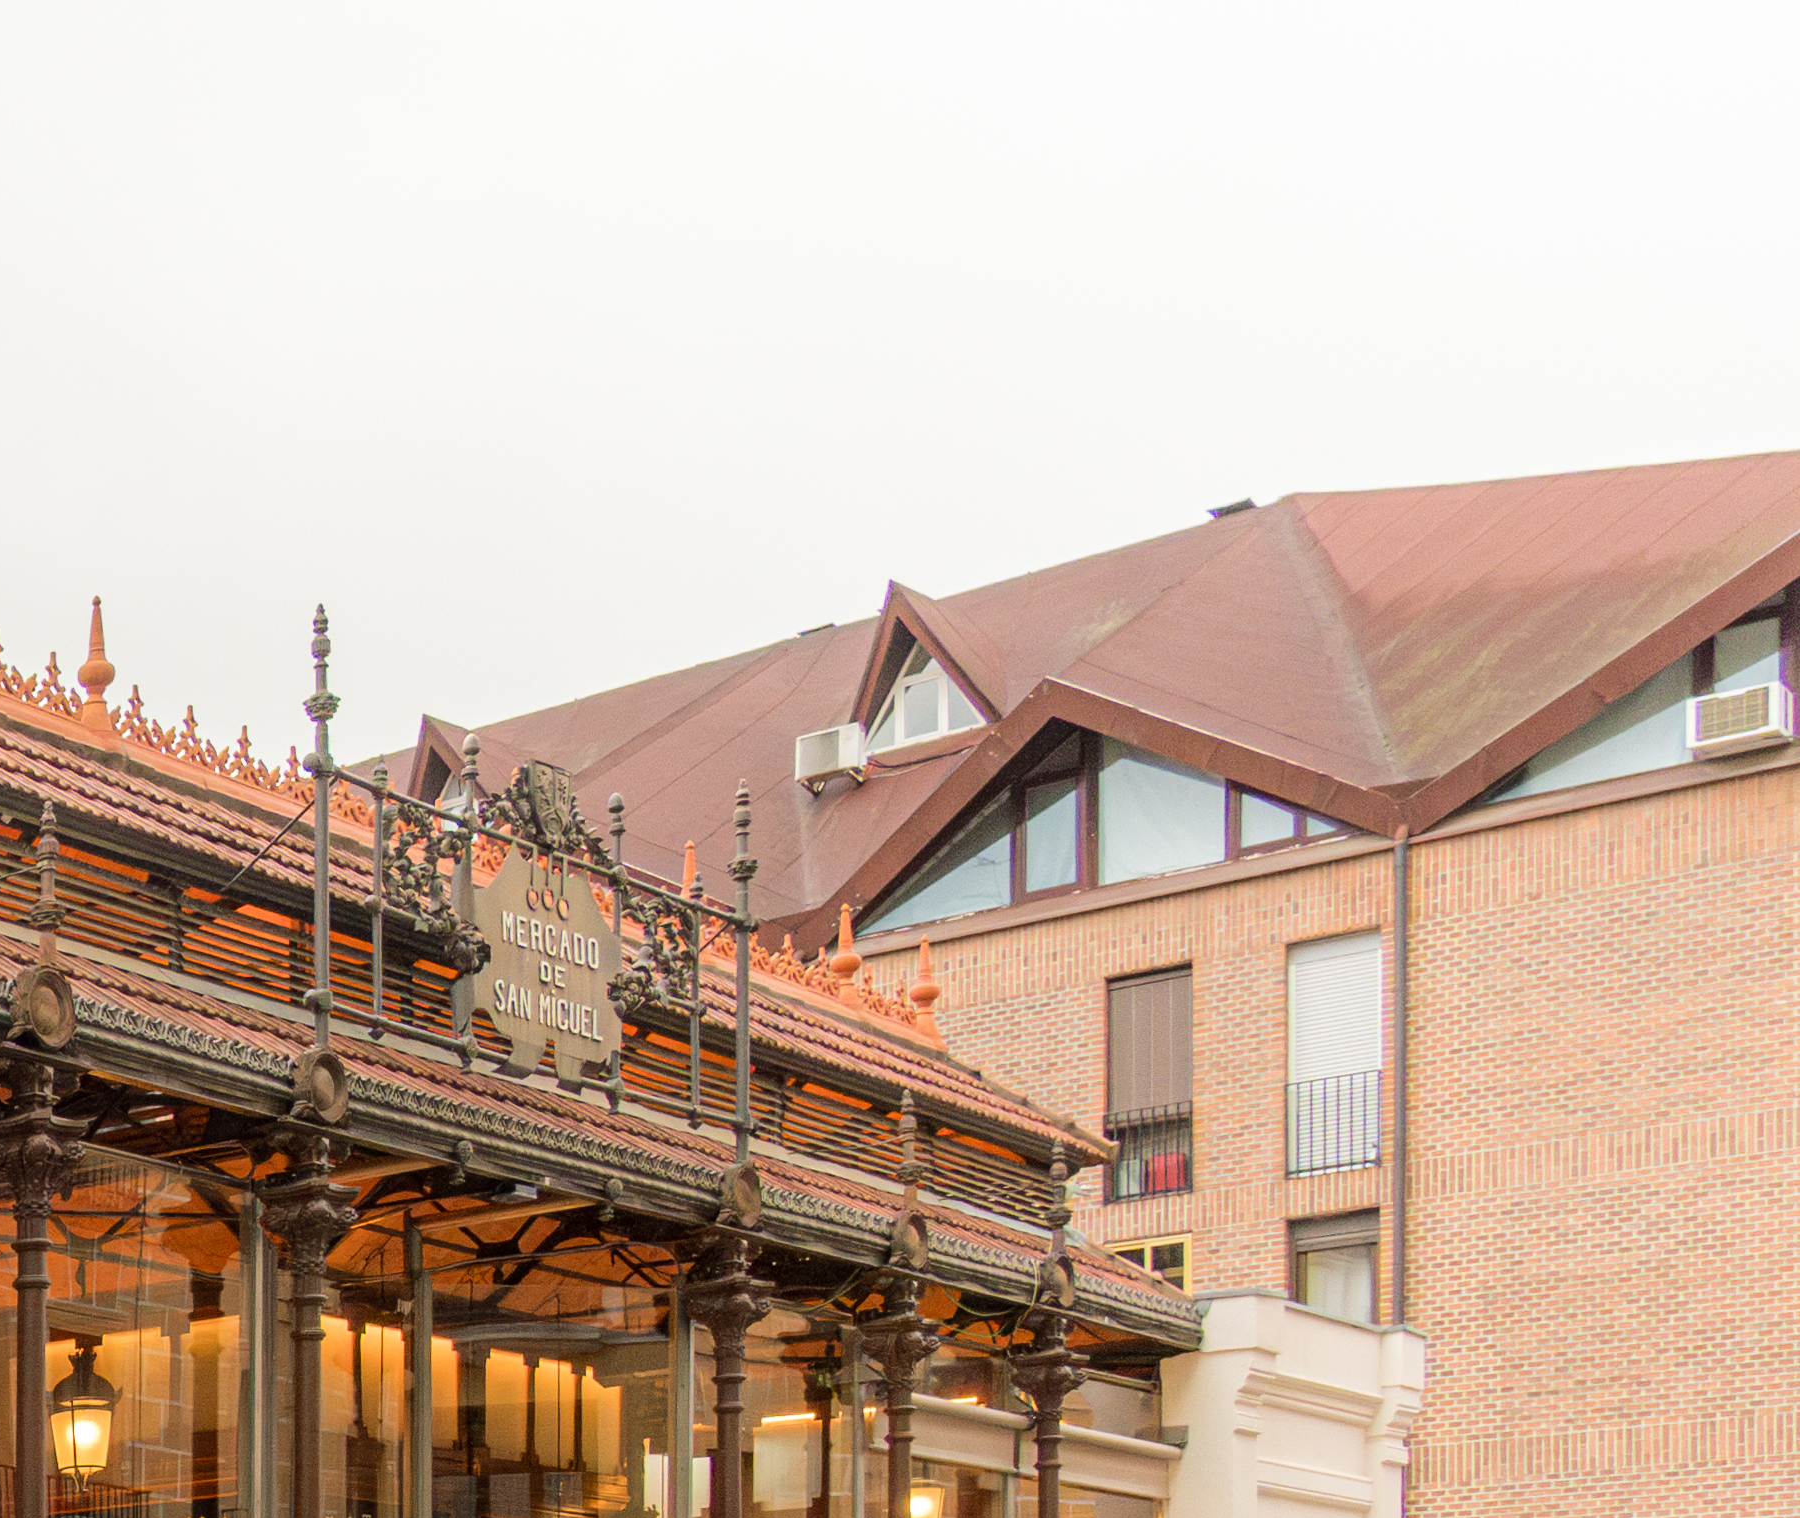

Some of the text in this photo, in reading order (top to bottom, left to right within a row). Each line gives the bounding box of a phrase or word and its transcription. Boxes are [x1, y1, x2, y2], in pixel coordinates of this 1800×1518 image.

[502, 910, 600, 970] MERCADO
[539, 961, 566, 988] DE
[494, 979, 532, 1020] SAN
